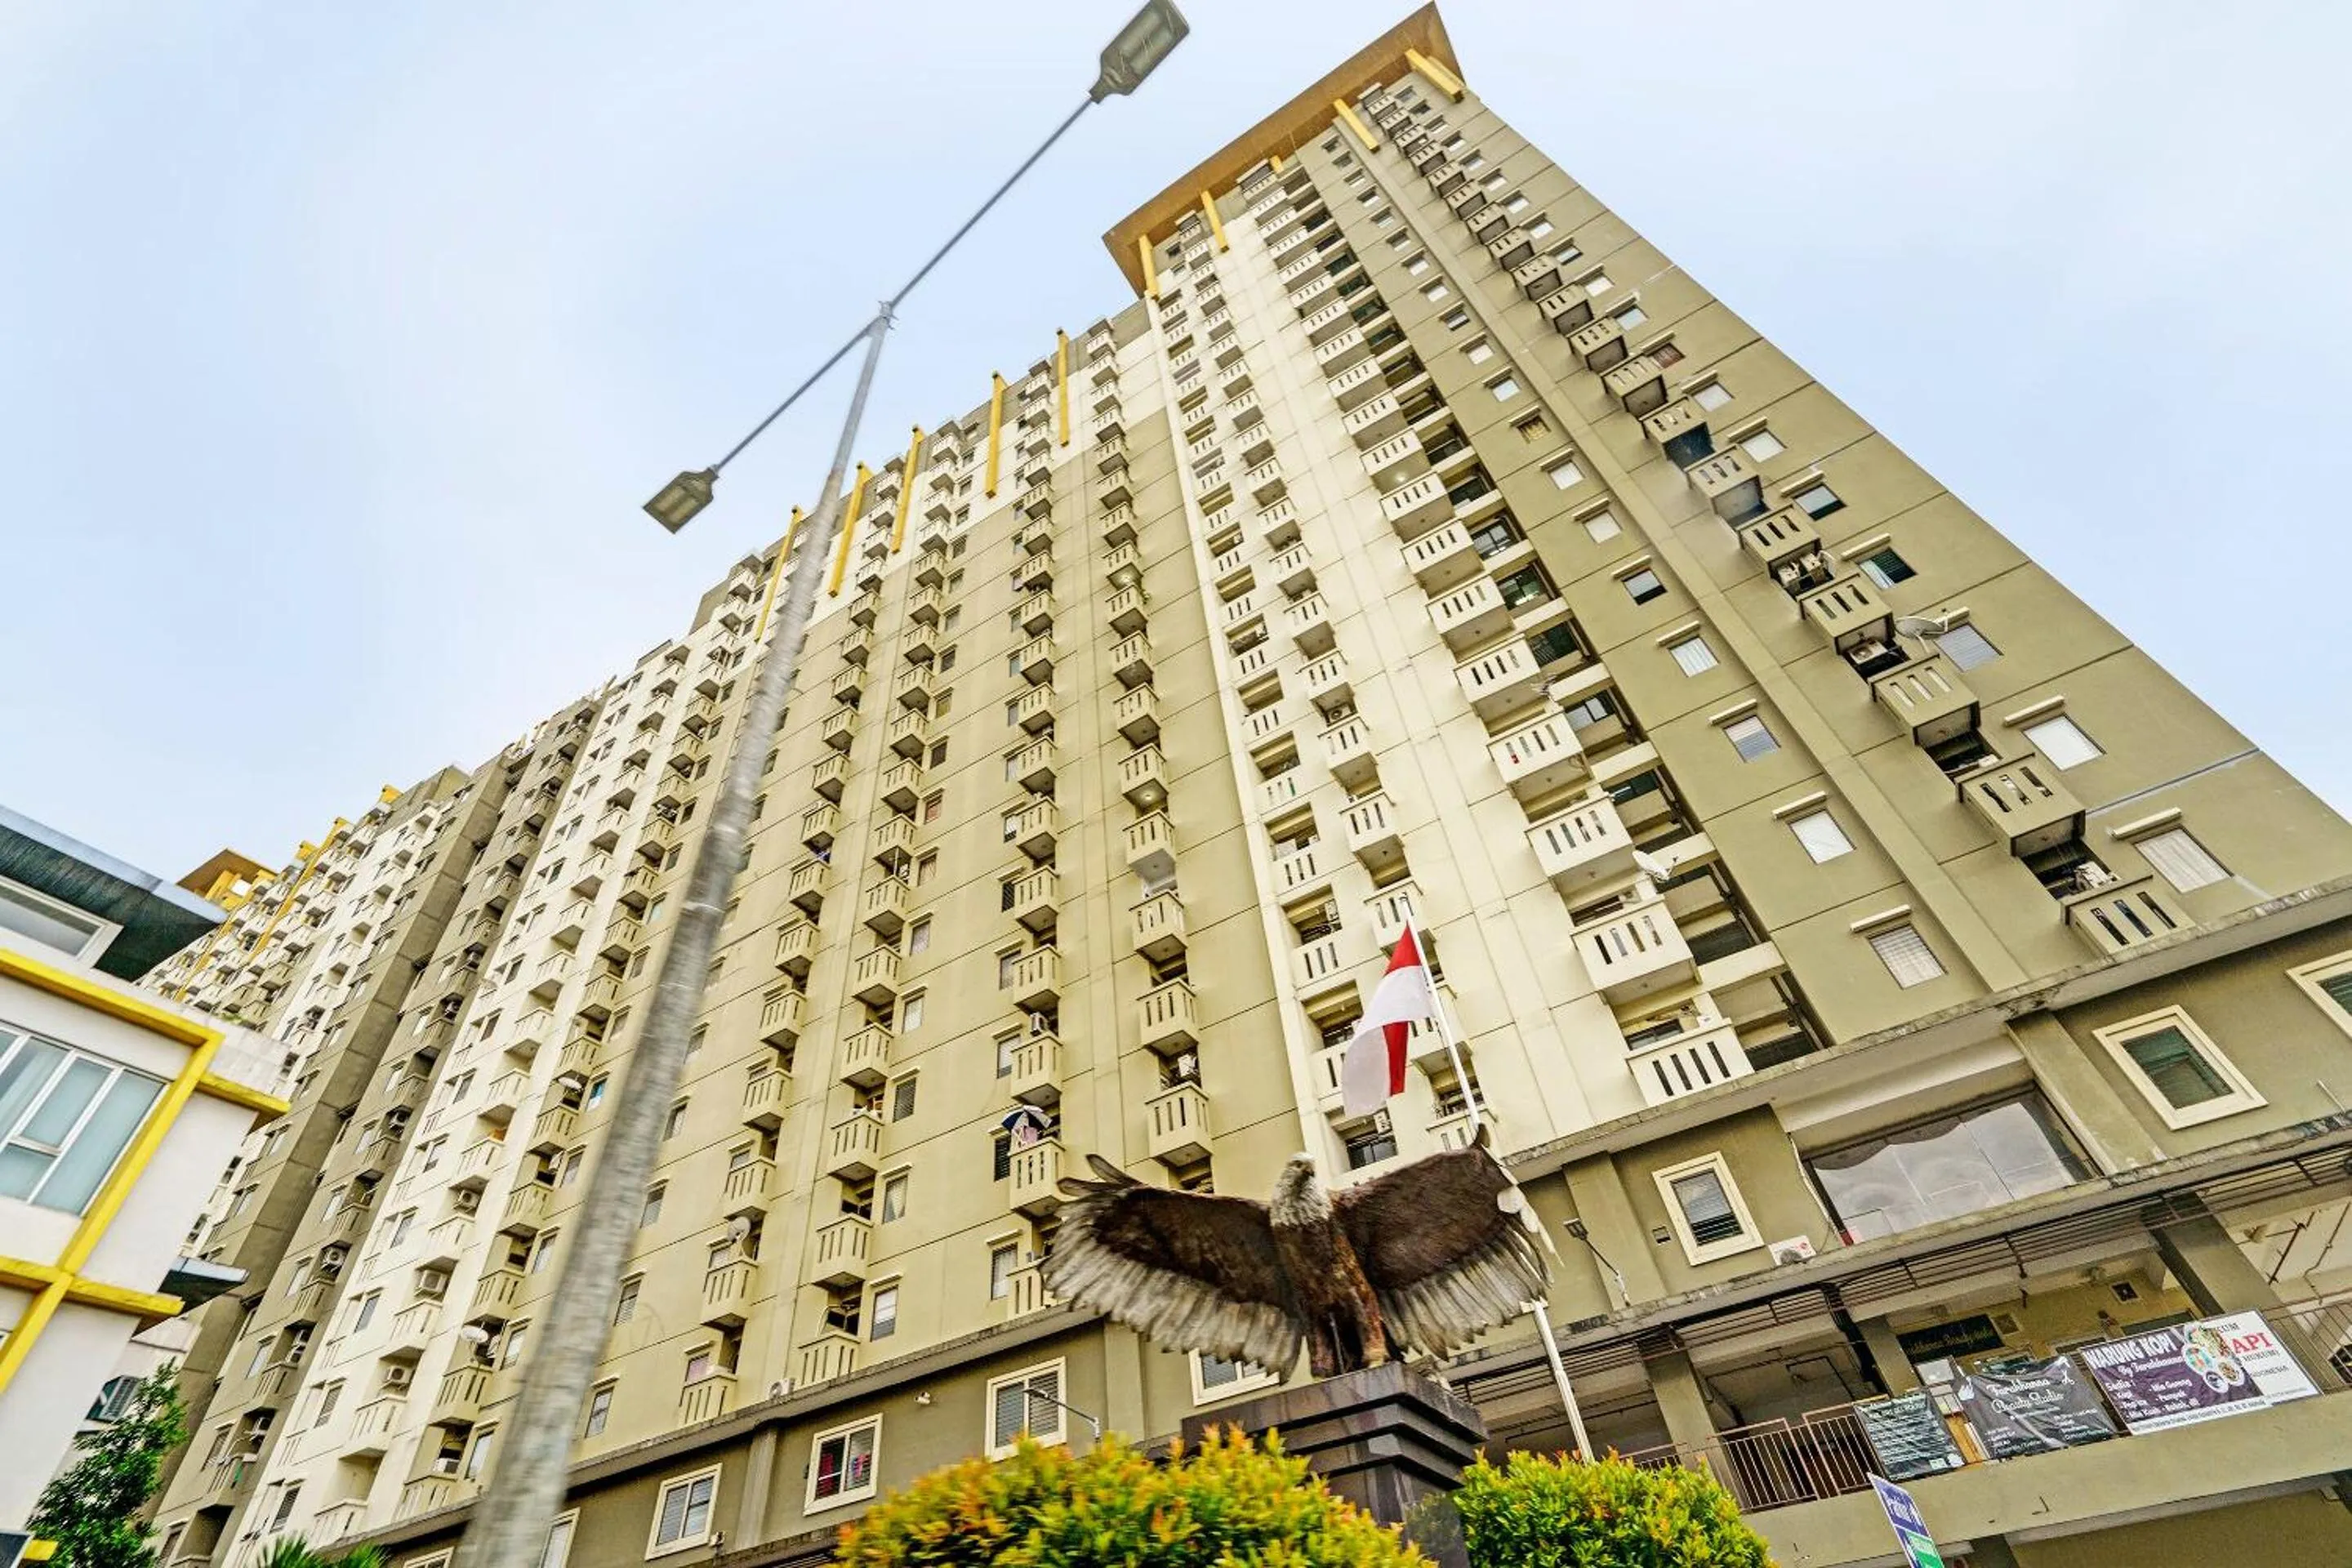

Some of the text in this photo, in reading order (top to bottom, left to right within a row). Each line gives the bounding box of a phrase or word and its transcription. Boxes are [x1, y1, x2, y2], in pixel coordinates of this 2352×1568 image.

[2082, 1332, 2179, 1370] WARUNG KOPI
[2231, 1332, 2273, 1354] API
